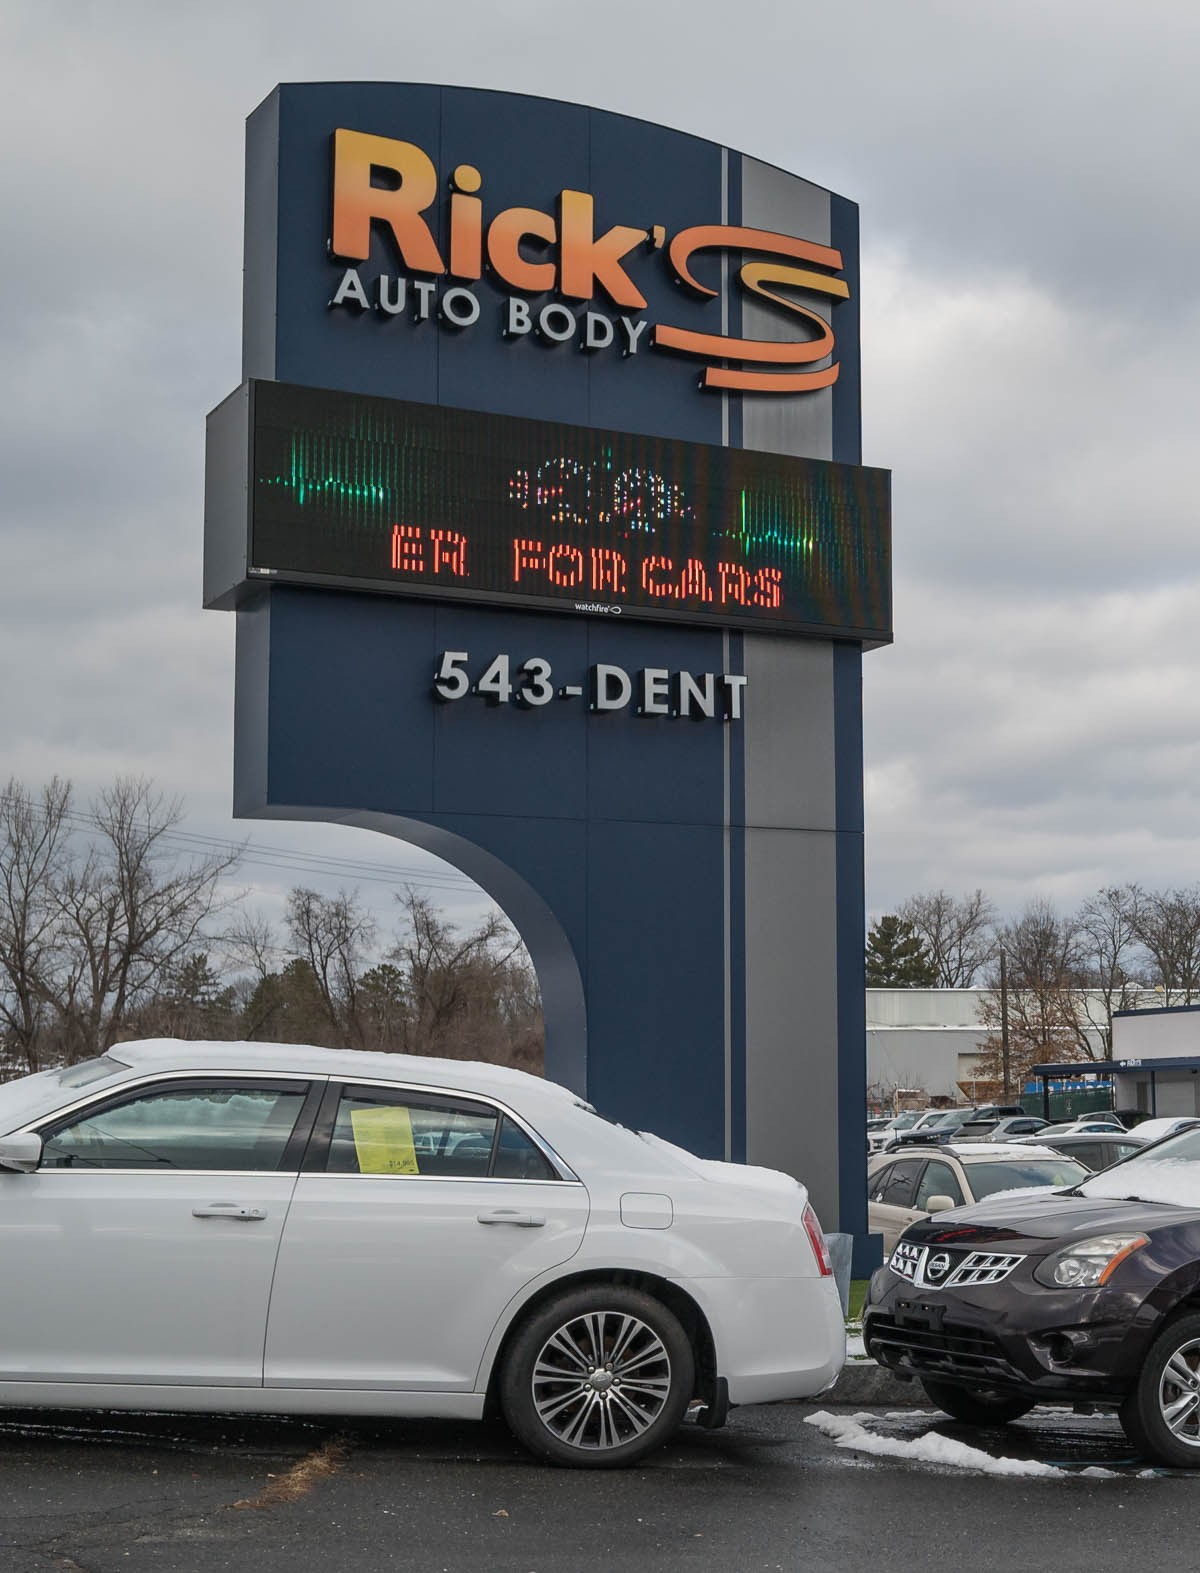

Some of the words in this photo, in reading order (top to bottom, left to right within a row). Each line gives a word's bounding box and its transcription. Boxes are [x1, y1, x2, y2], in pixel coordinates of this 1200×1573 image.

[332, 268, 481, 327] AUTO
[507, 296, 648, 356] BODY
[391, 524, 470, 577] ER
[513, 537, 627, 593] FOR
[642, 555, 783, 608] CARS
[575, 602, 609, 614] watchfire
[435, 650, 749, 720] 543-DENT
